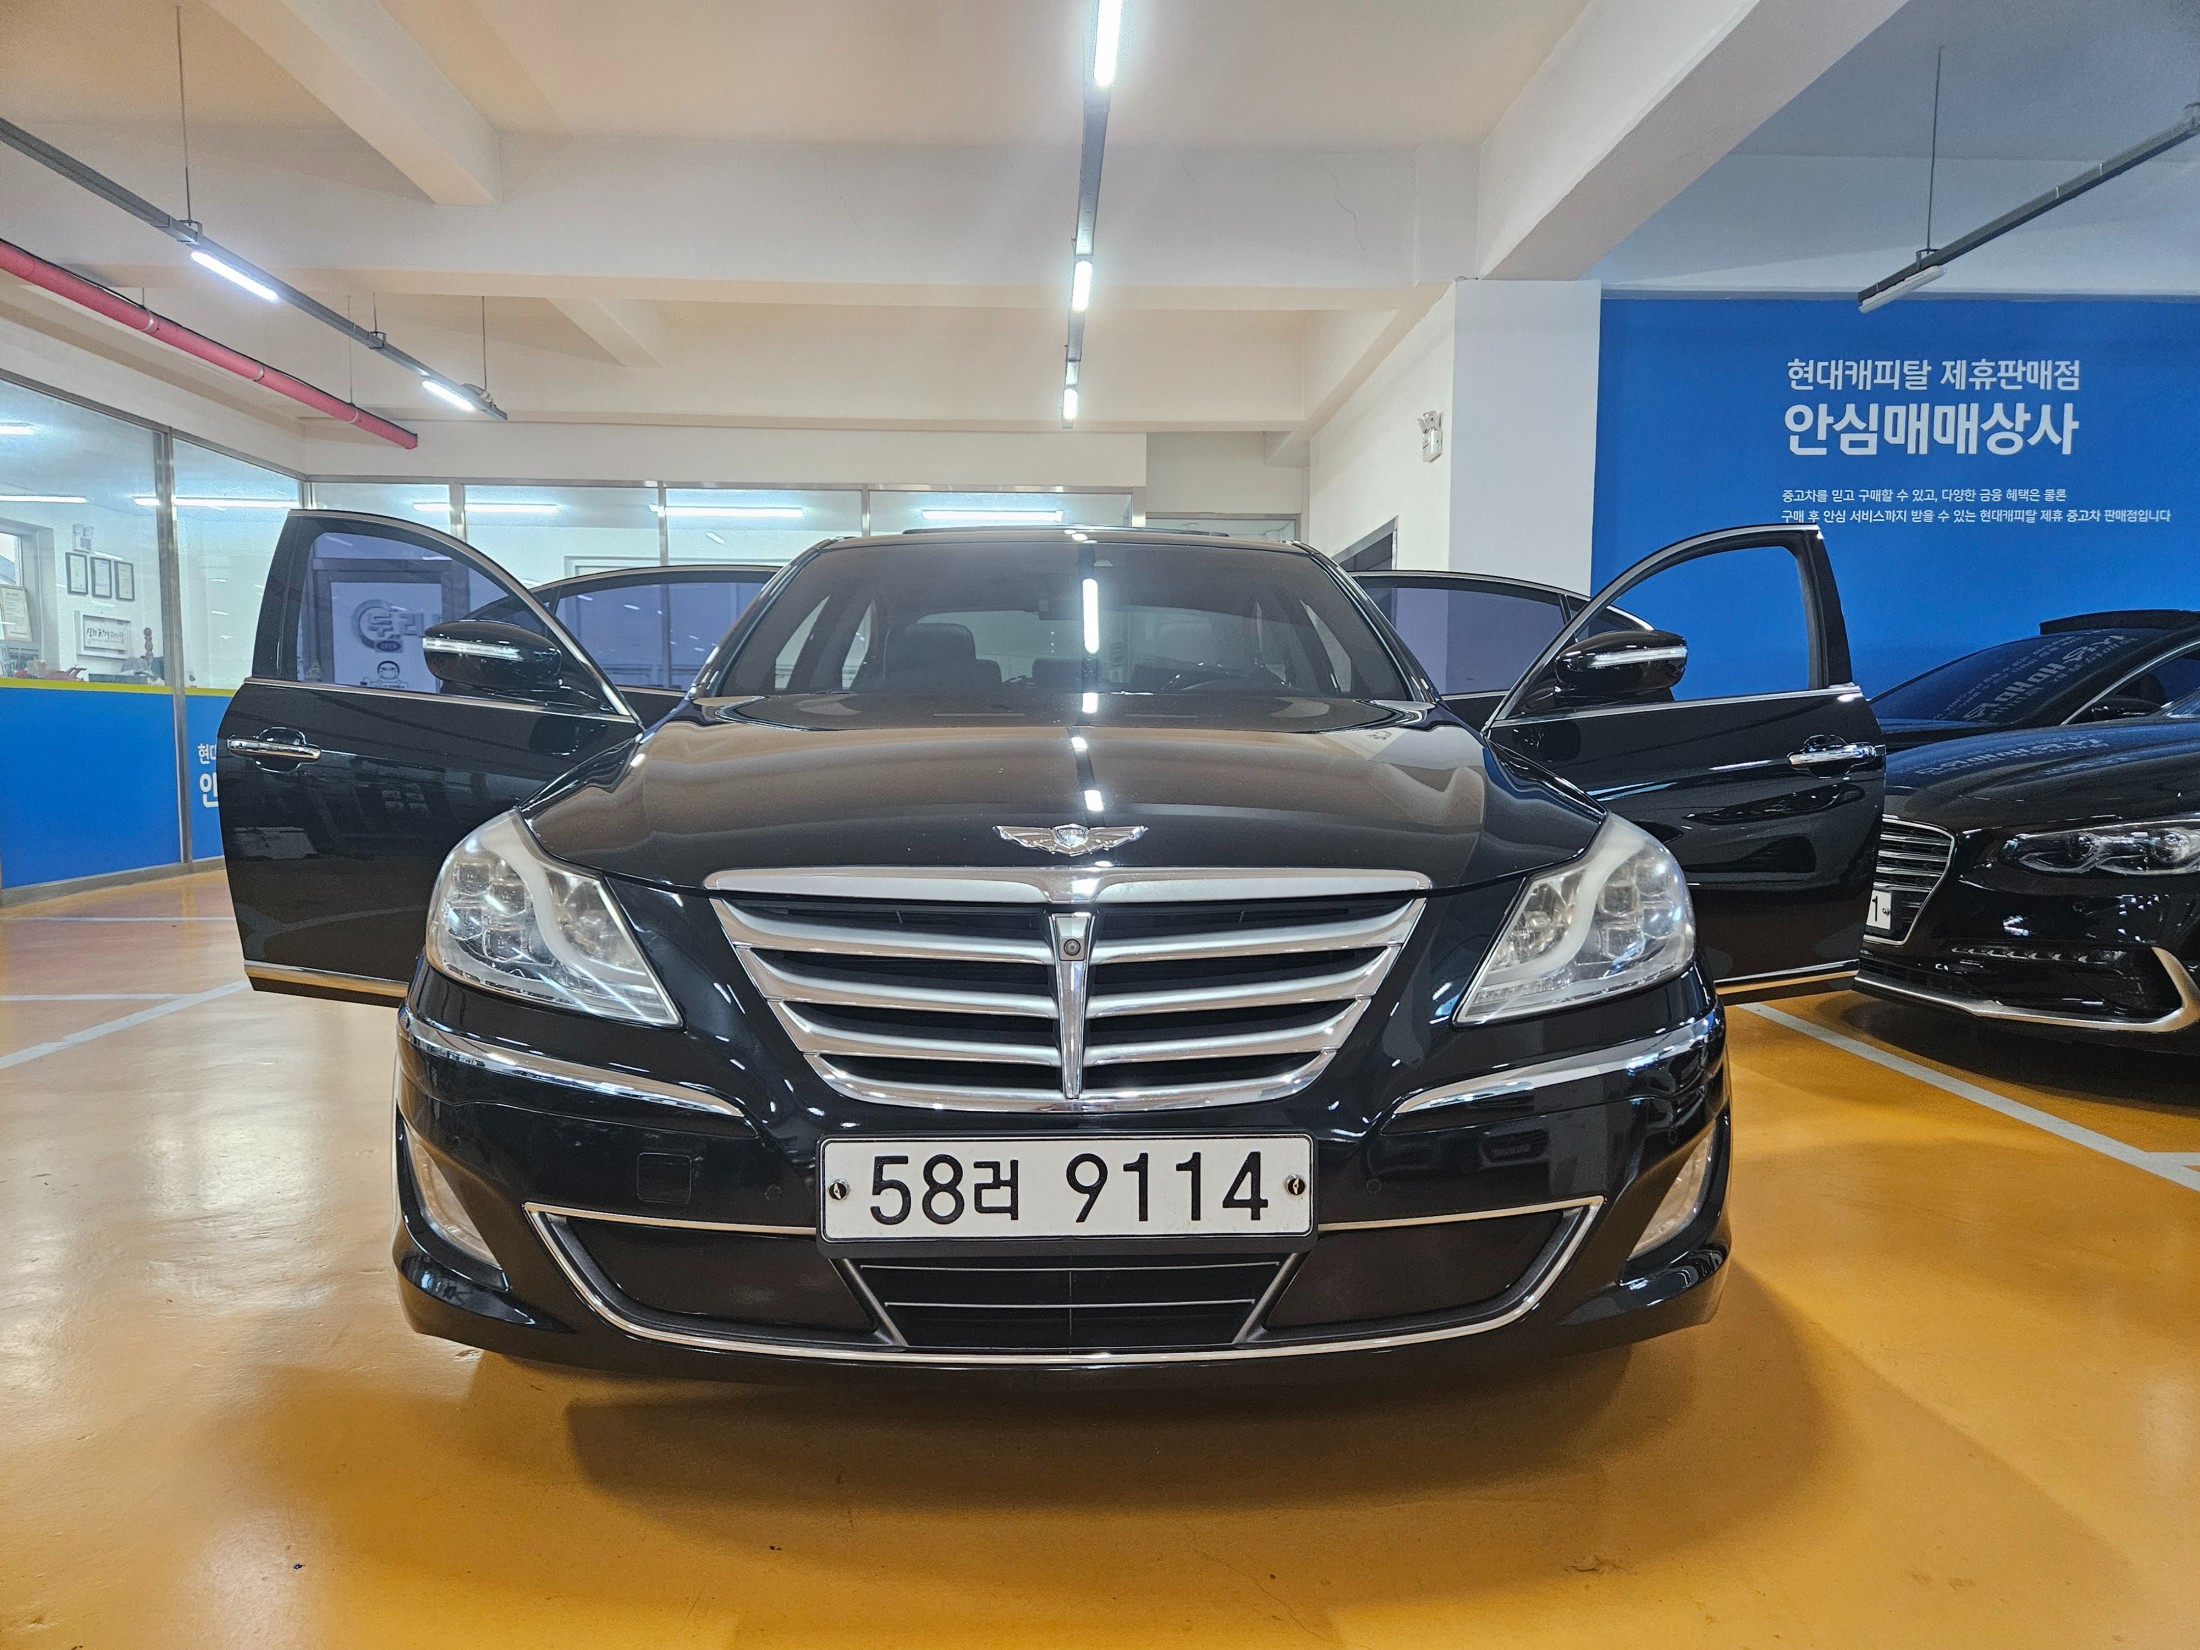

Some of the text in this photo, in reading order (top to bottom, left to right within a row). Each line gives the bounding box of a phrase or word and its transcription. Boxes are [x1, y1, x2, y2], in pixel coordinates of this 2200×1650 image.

[1787, 358, 2080, 391] 현대캐피탈 제휴판매점
[1784, 402, 2080, 456] 안심매매상사
[1781, 488, 2067, 503] 중고차를 믿고 구매할 수 있고, 다양한 금융 혜택은 물론
[1781, 509, 2171, 524] 구매 후 안심 서비스까지 받을 수 있는 현대캐피탈 제휴 중고차 판매점입니다
[870, 1151, 1269, 1225] 58러 9114
